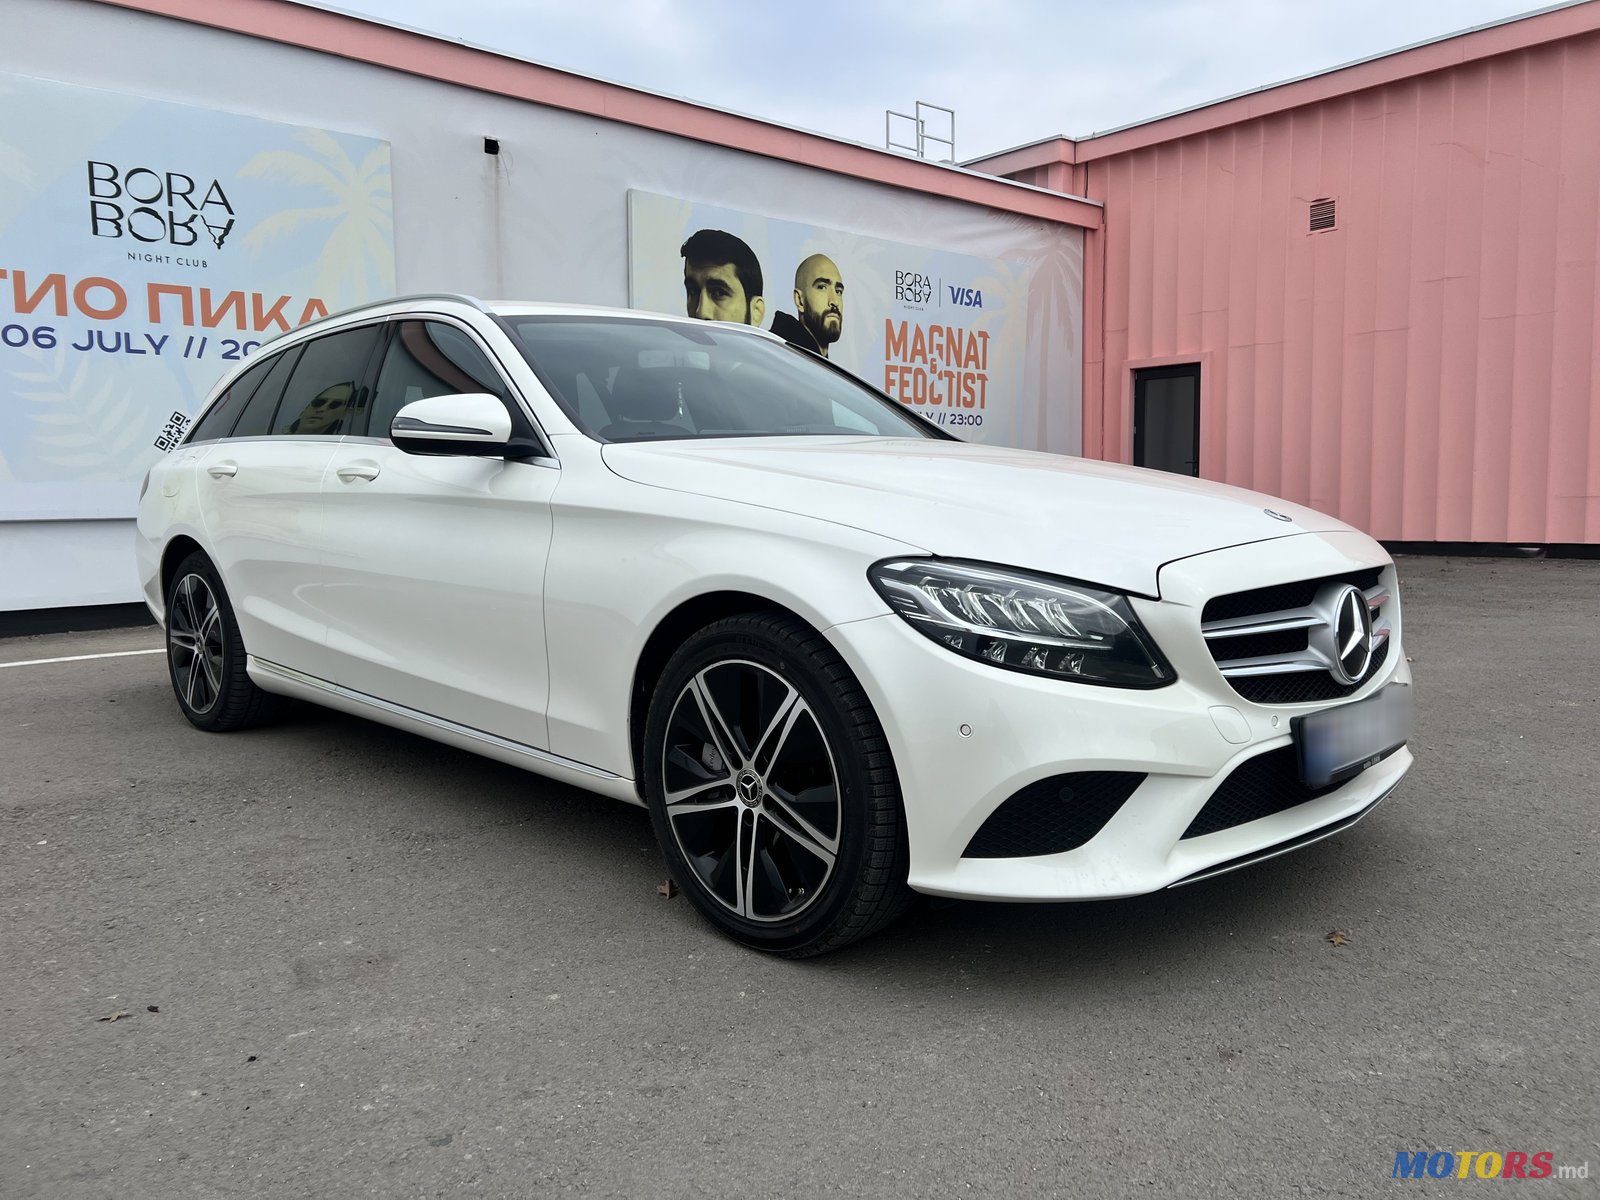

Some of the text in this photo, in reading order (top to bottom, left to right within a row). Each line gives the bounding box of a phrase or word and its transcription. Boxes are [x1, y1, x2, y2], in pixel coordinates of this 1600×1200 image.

[87, 160, 235, 216] BORA
[127, 252, 208, 268] NIGHT CLUB
[0, 268, 128, 320] ИО
[895, 270, 932, 290] BORA
[947, 285, 983, 308] VISA
[1, 324, 57, 349] 06
[72, 329, 169, 356] JULY
[885, 318, 990, 371] MAGNAT
[885, 364, 989, 410] FEOCTIST
[950, 413, 983, 426] 23:00
